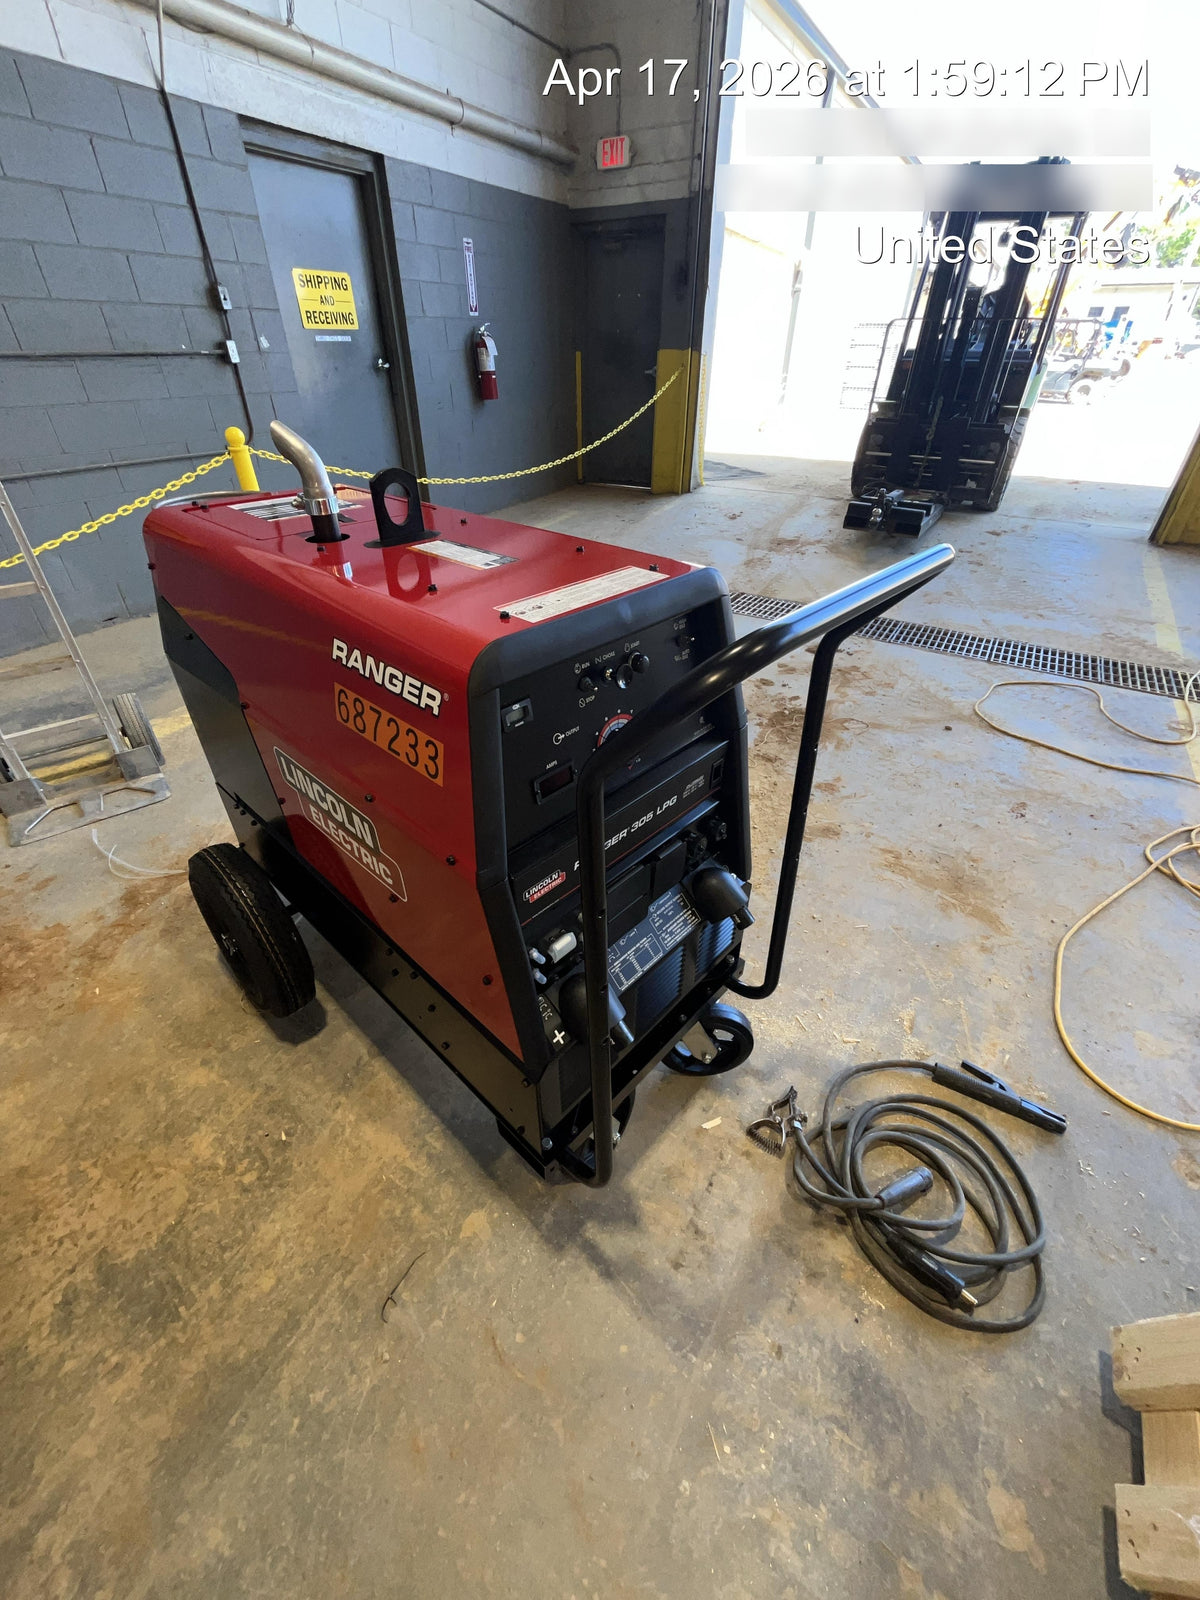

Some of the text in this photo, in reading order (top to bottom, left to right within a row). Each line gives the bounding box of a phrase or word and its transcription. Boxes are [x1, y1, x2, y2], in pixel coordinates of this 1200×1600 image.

[602, 137, 625, 167] EXIT
[298, 273, 349, 291] SHIPPING
[319, 295, 335, 306] AND
[305, 310, 355, 326] RECEIVING
[337, 688, 440, 780] 687233
[565, 725, 580, 737] OUTPUT
[280, 756, 375, 849] LINCOLN
[630, 811, 654, 833] 305
[656, 795, 678, 815] LPG
[309, 803, 393, 885] ELECTRIC
[525, 872, 559, 898] LINCOLN
[533, 876, 562, 900] ELECTRIC
